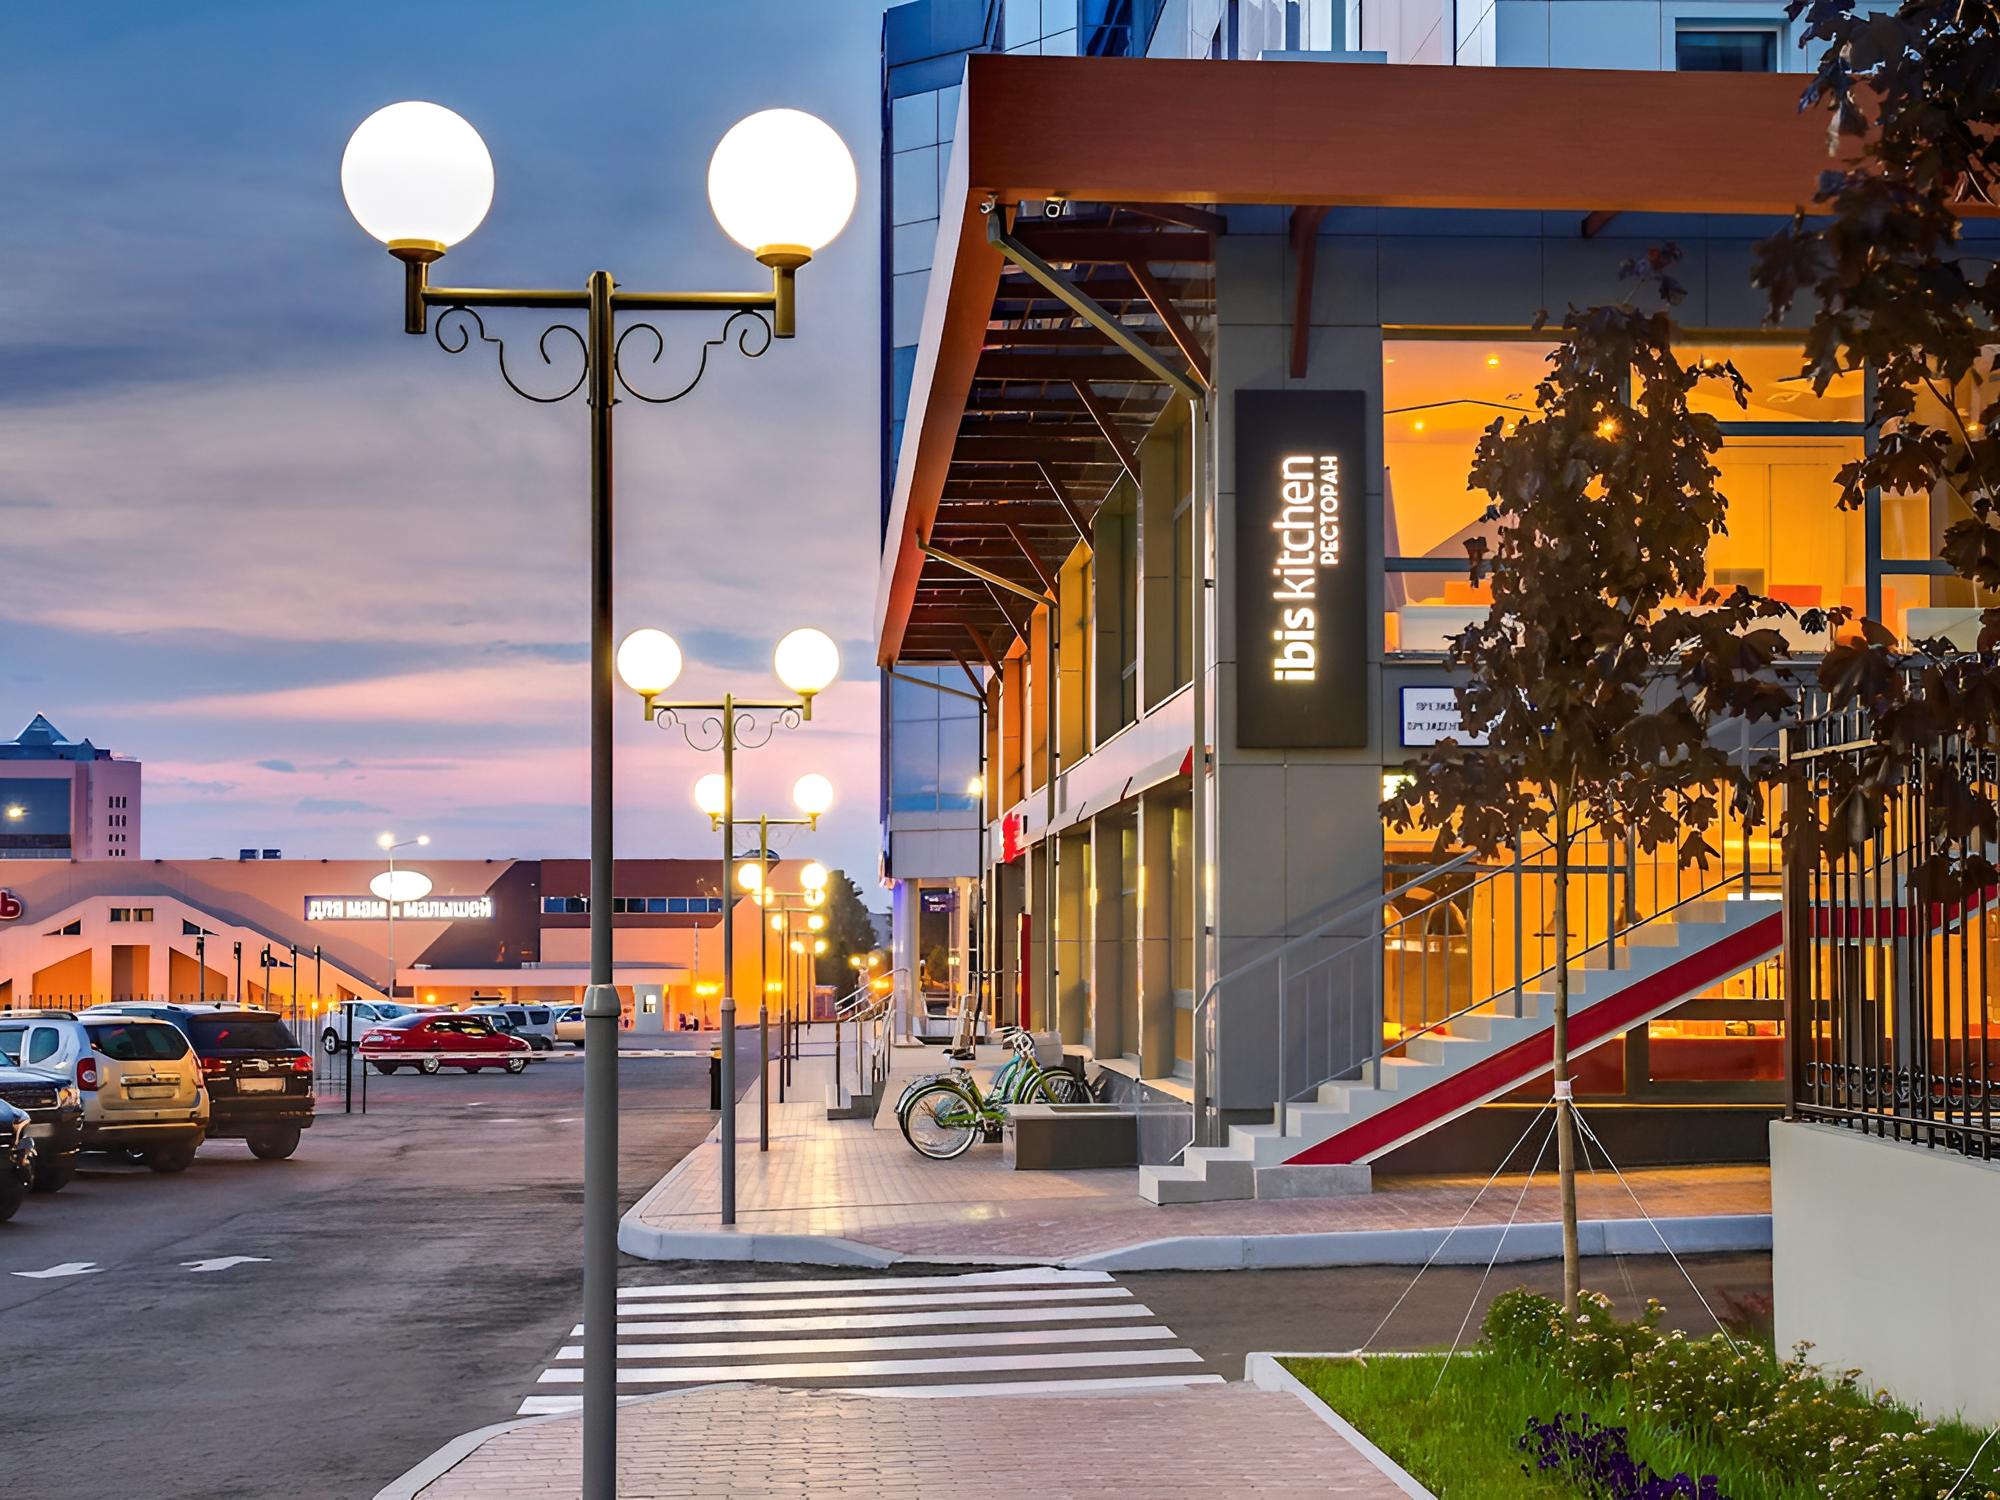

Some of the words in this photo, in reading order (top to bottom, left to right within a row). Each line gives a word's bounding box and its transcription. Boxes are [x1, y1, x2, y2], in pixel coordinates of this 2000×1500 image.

[1273, 456, 1315, 599] kitchen
[1320, 456, 1339, 564] РЕСТОРАН
[1274, 608, 1315, 681] ibis
